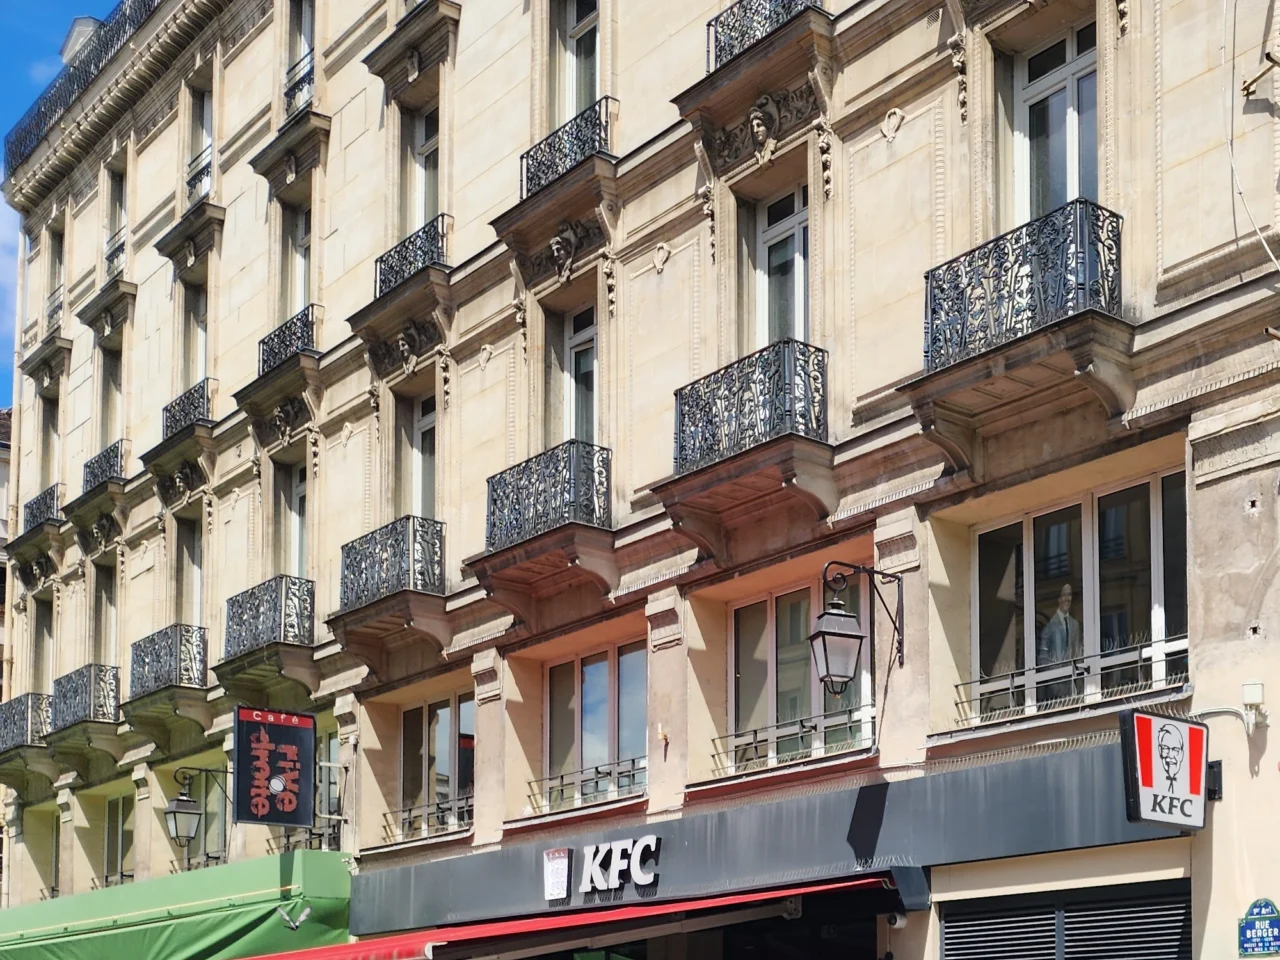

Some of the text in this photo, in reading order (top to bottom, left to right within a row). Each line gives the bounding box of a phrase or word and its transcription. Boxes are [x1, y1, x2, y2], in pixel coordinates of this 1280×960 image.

[252, 711, 299, 725] Café
[1151, 793, 1193, 818] KFC
[579, 834, 657, 893] KFC
[1255, 920, 1270, 930] RUE
[1246, 927, 1279, 938] BERGER
